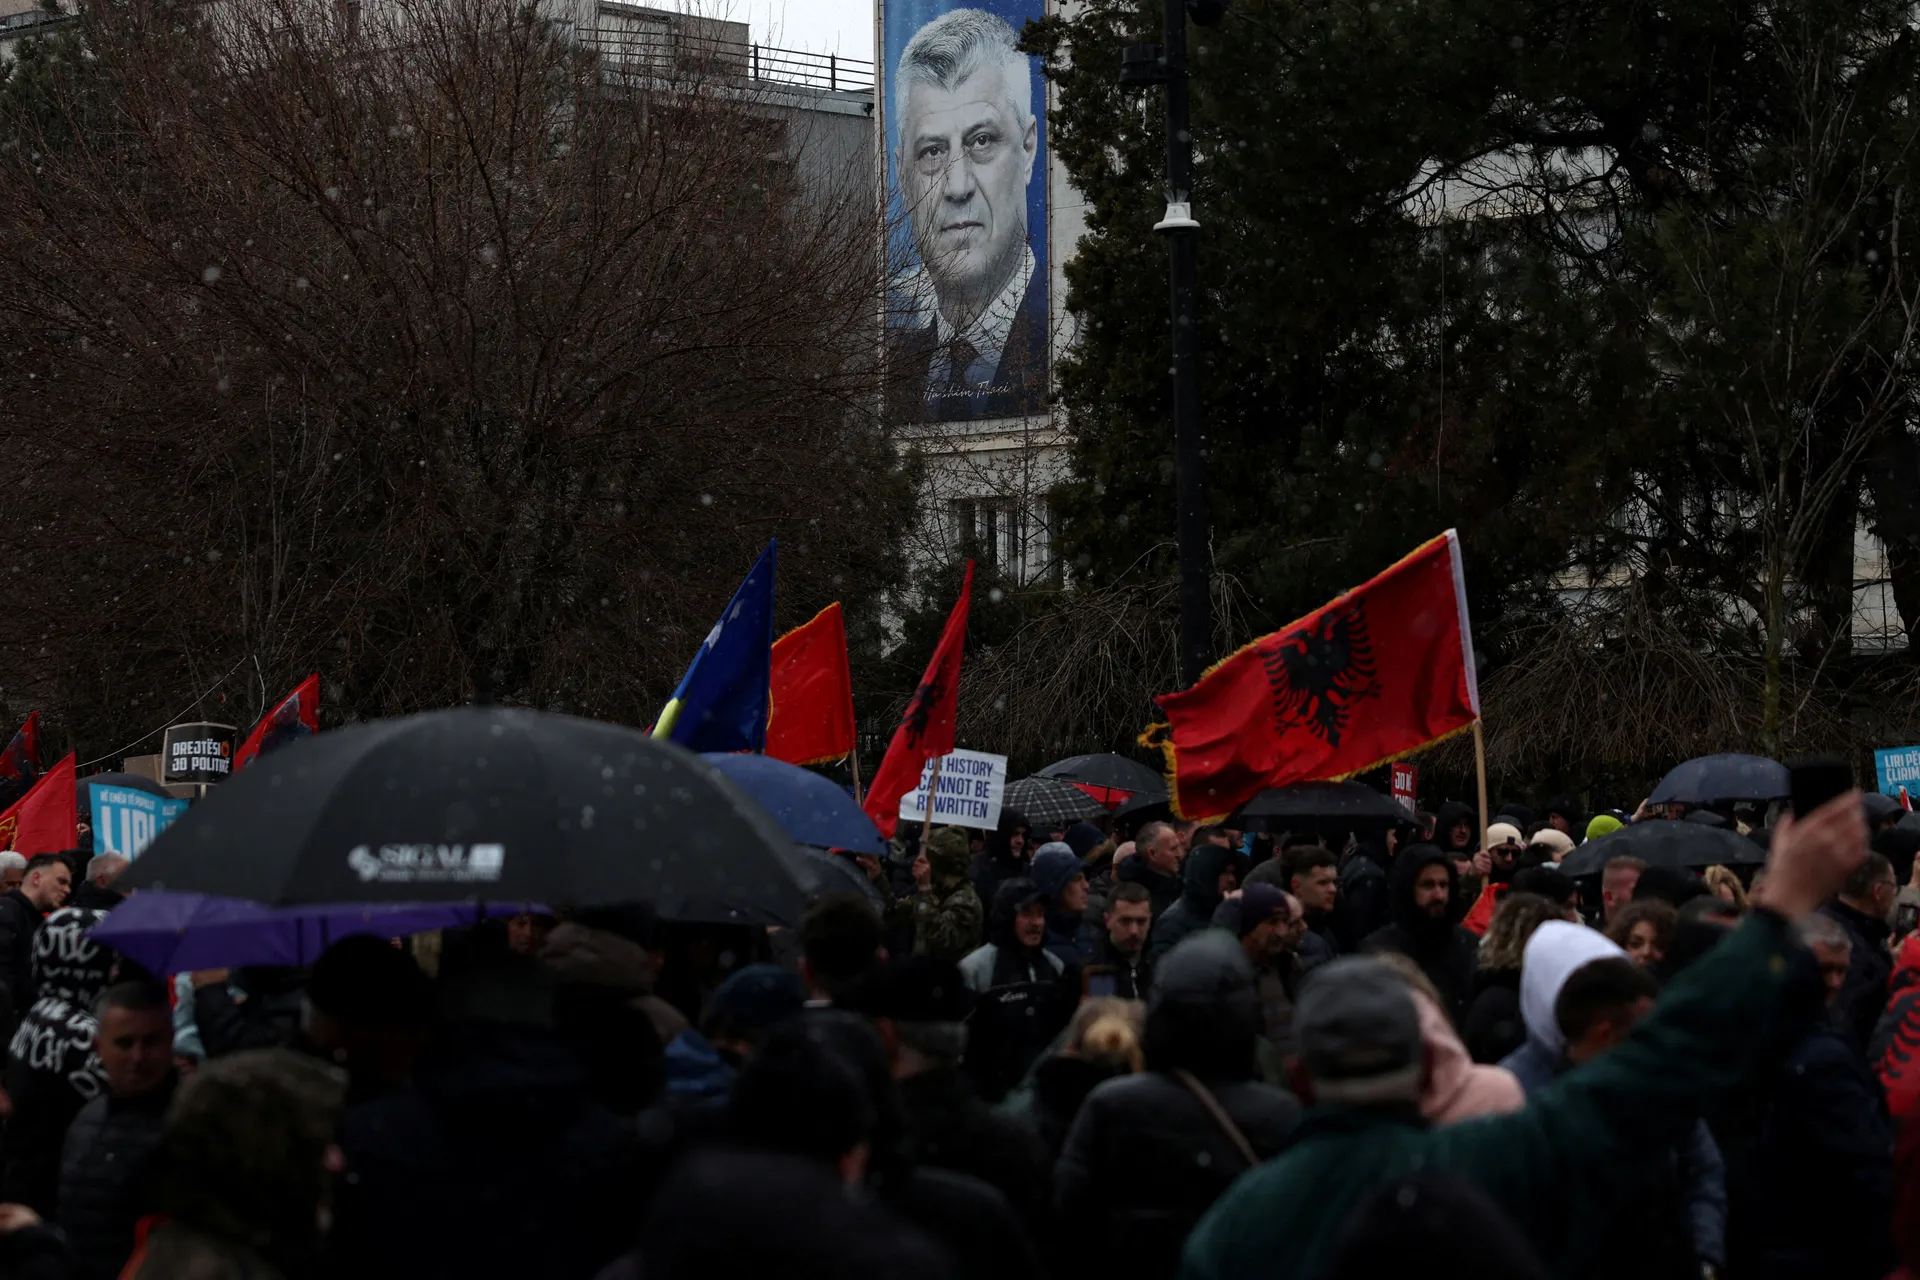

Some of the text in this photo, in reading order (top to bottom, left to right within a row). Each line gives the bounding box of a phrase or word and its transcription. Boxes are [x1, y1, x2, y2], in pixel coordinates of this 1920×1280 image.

[172, 757, 188, 772] JO
[946, 757, 994, 777] HISTORY
[1884, 755, 1904, 767] LIRI
[974, 780, 991, 799] BE
[1395, 771, 1405, 790] JO
